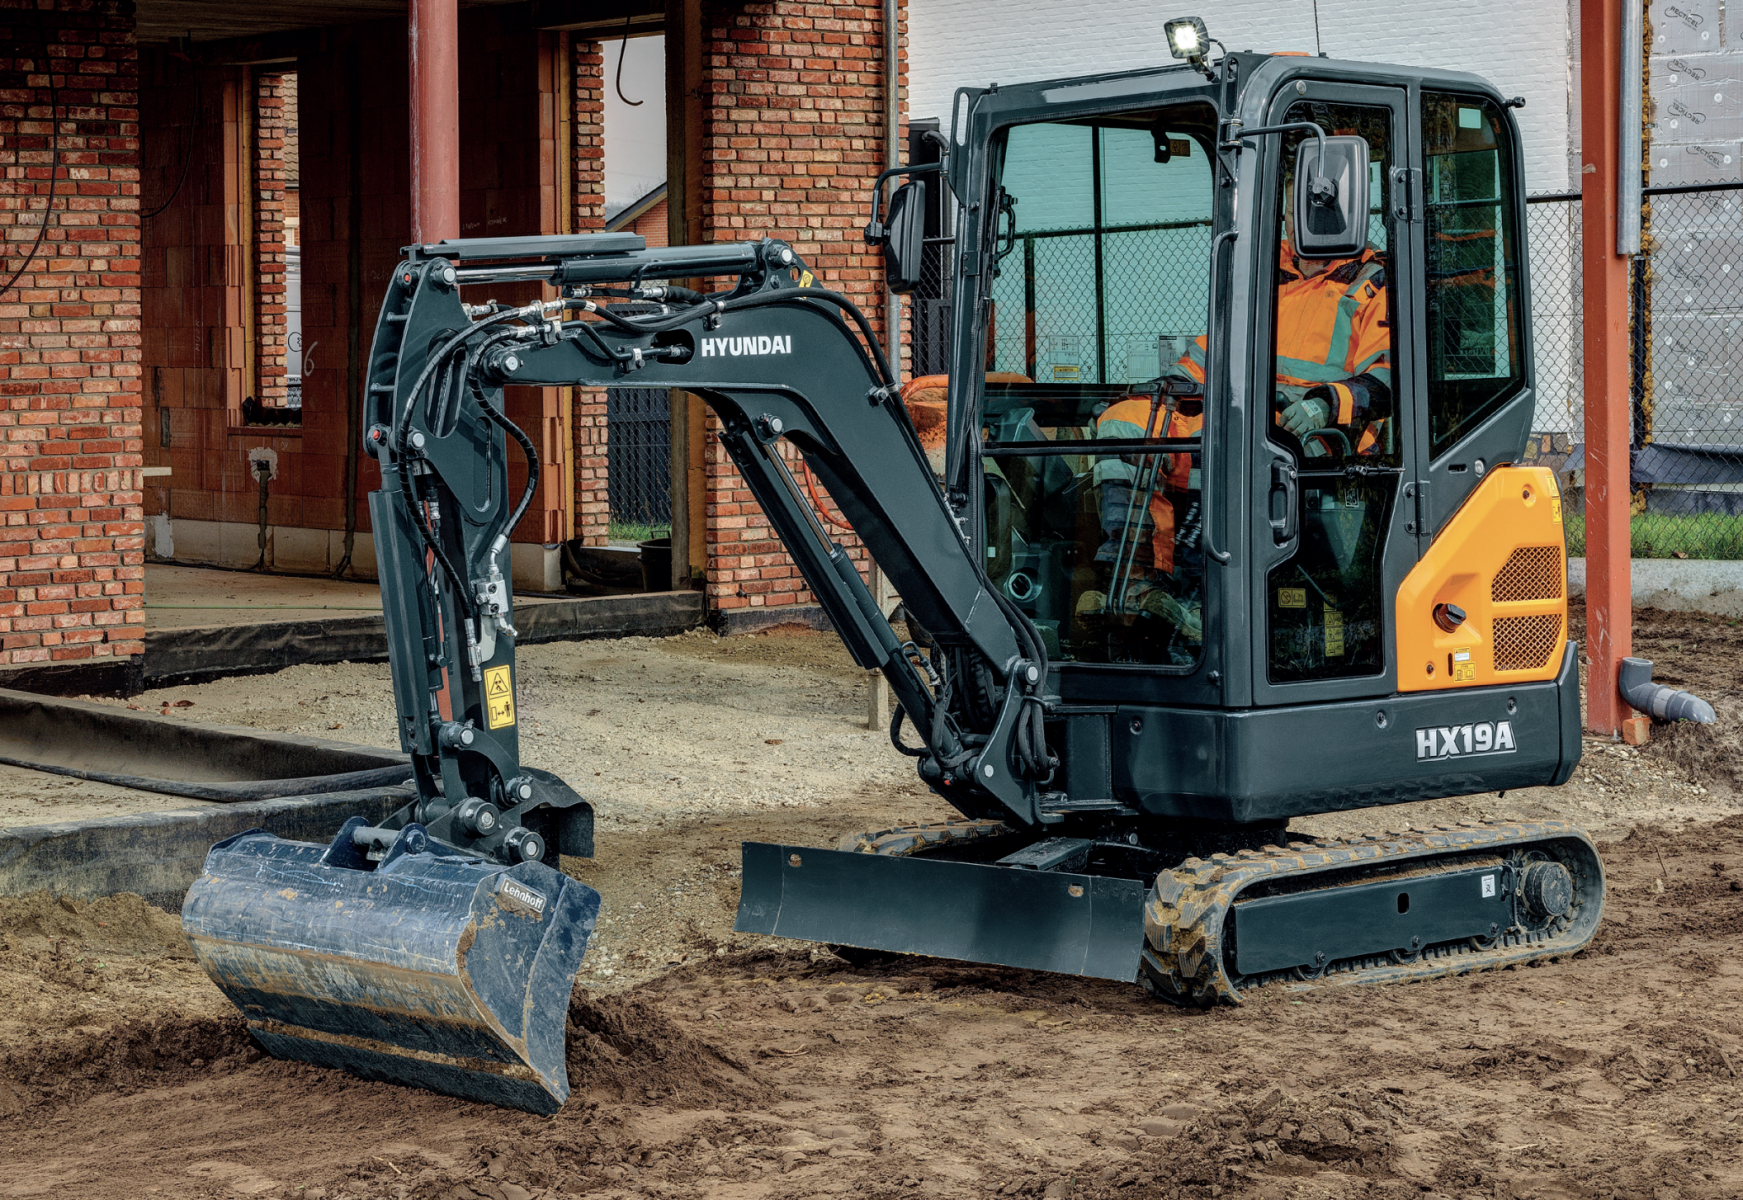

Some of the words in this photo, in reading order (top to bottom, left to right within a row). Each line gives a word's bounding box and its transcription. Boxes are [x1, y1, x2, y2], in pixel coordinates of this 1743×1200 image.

[1670, 5, 1698, 28] RECTICEL
[1672, 102, 1700, 125] RECTICEL
[701, 335, 792, 357] HYUNDAI
[303, 341, 318, 377] 6
[1416, 720, 1516, 760] HX19A
[503, 882, 544, 909] Lehnhoff
